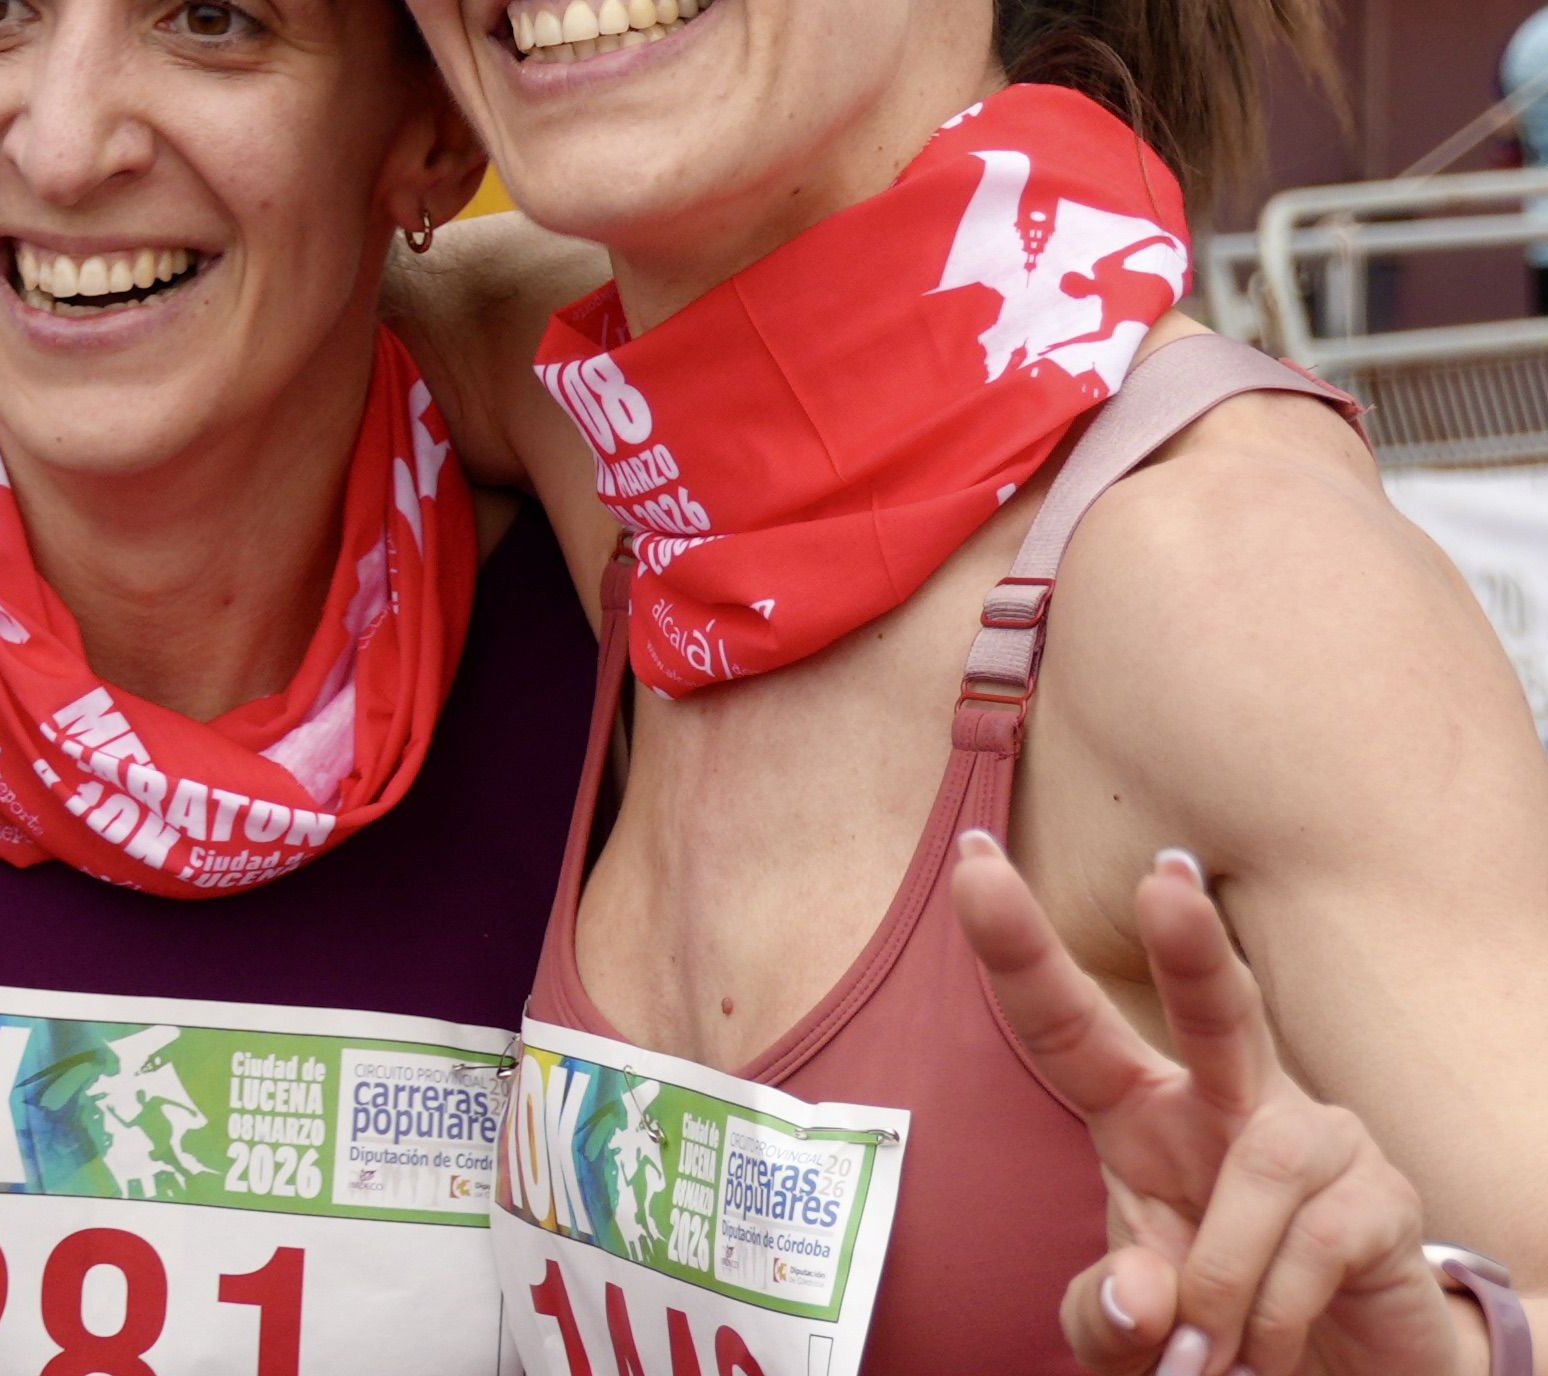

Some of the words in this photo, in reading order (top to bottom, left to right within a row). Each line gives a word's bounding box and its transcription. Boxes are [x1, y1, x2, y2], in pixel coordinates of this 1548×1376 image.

[190, 846, 282, 872] Ciudad
[231, 1051, 298, 1080] Ciudad
[301, 1056, 326, 1082] de
[354, 1063, 414, 1081] CIRCUITO
[417, 1068, 488, 1090] PROVINCIAL
[229, 1076, 324, 1114] LUCENA
[354, 1080, 489, 1117] carreras
[351, 1103, 497, 1145] populare
[224, 1140, 323, 1200] 2026
[349, 1145, 429, 1166] Diputación
[433, 1152, 452, 1168] de
[455, 1152, 493, 1171] Córd
[727, 1150, 821, 1196] carreras
[823, 1155, 852, 1177] 20
[723, 1177, 841, 1228] populares
[818, 1176, 845, 1198] 26
[668, 1207, 710, 1273] 2026
[721, 1219, 762, 1248] Diputación
[776, 1233, 831, 1259] Córdoba
